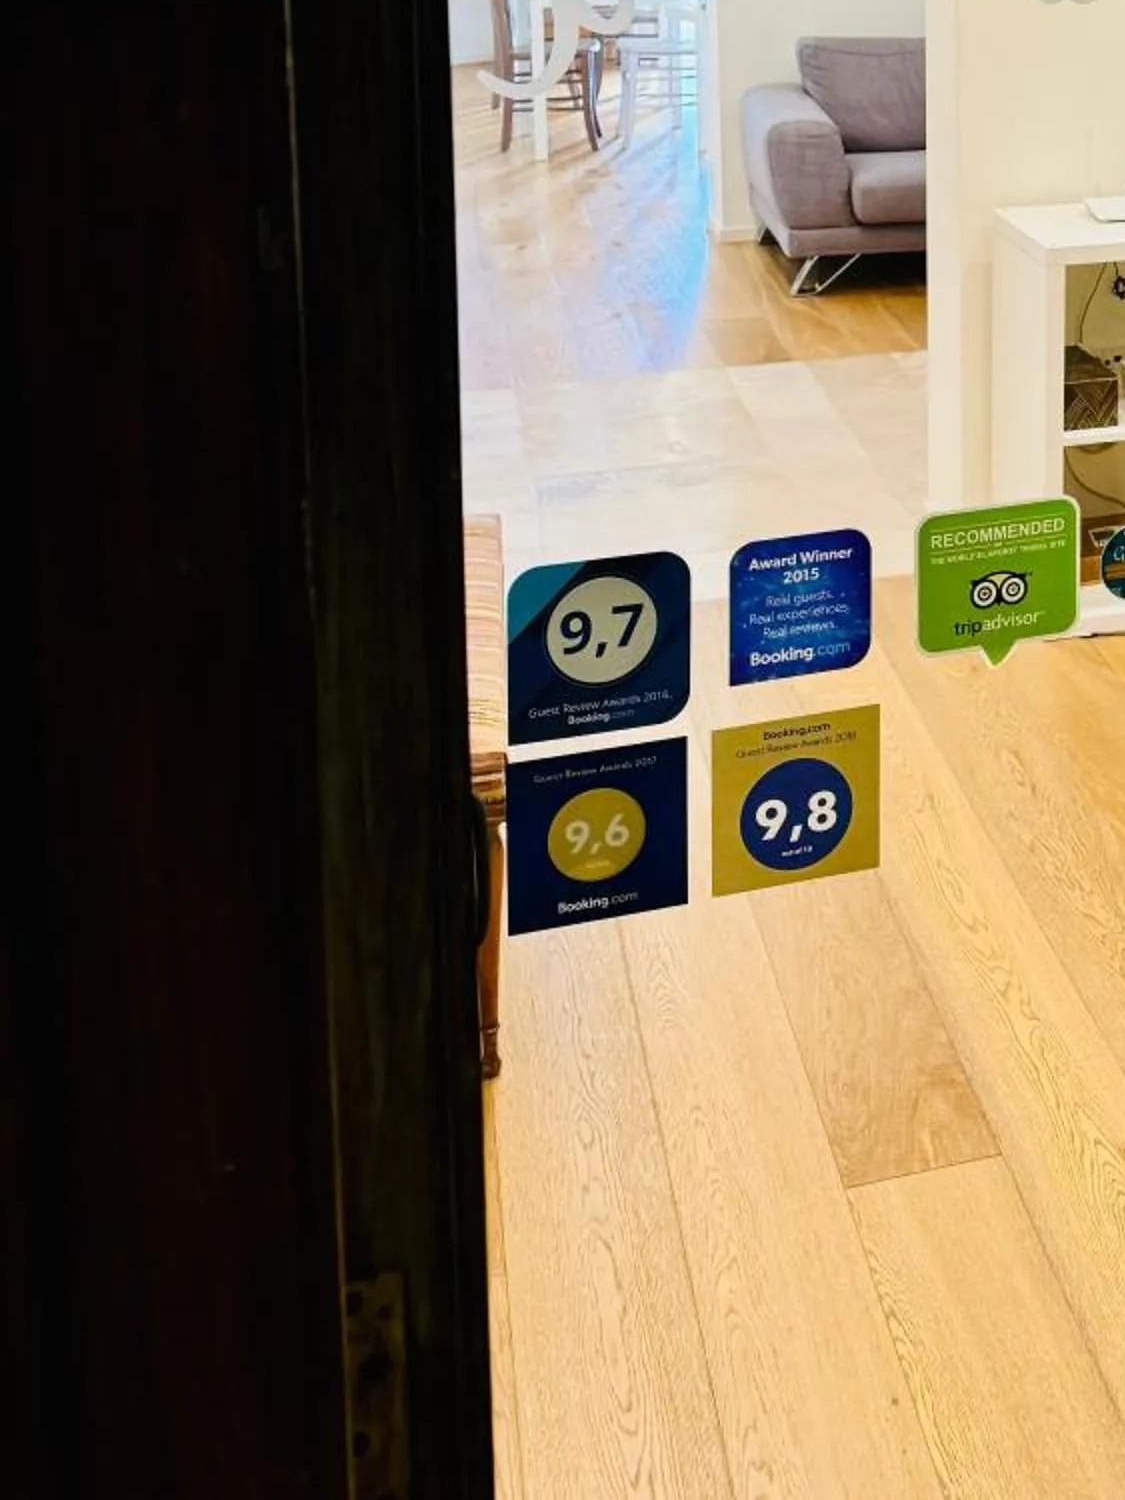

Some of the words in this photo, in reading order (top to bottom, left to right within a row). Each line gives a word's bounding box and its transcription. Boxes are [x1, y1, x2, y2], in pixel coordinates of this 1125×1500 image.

[930, 517, 1066, 549] RECOMMENDED
[749, 552, 797, 572] Award
[800, 547, 854, 565] Winner
[783, 567, 820, 585] 2015
[765, 592, 791, 607] Real
[749, 611, 775, 625] Real
[955, 612, 1041, 637] tripadvisor
[559, 603, 645, 660] 9,7
[763, 625, 787, 639] Real
[750, 641, 852, 667] Booking.com
[528, 706, 561, 720] Guest
[563, 701, 601, 714] Review
[567, 709, 636, 726] Booking.com
[763, 722, 831, 741] Booking.com
[755, 789, 838, 843] 9,8
[564, 813, 630, 855] 9,6
[557, 891, 640, 915] Booking.com
